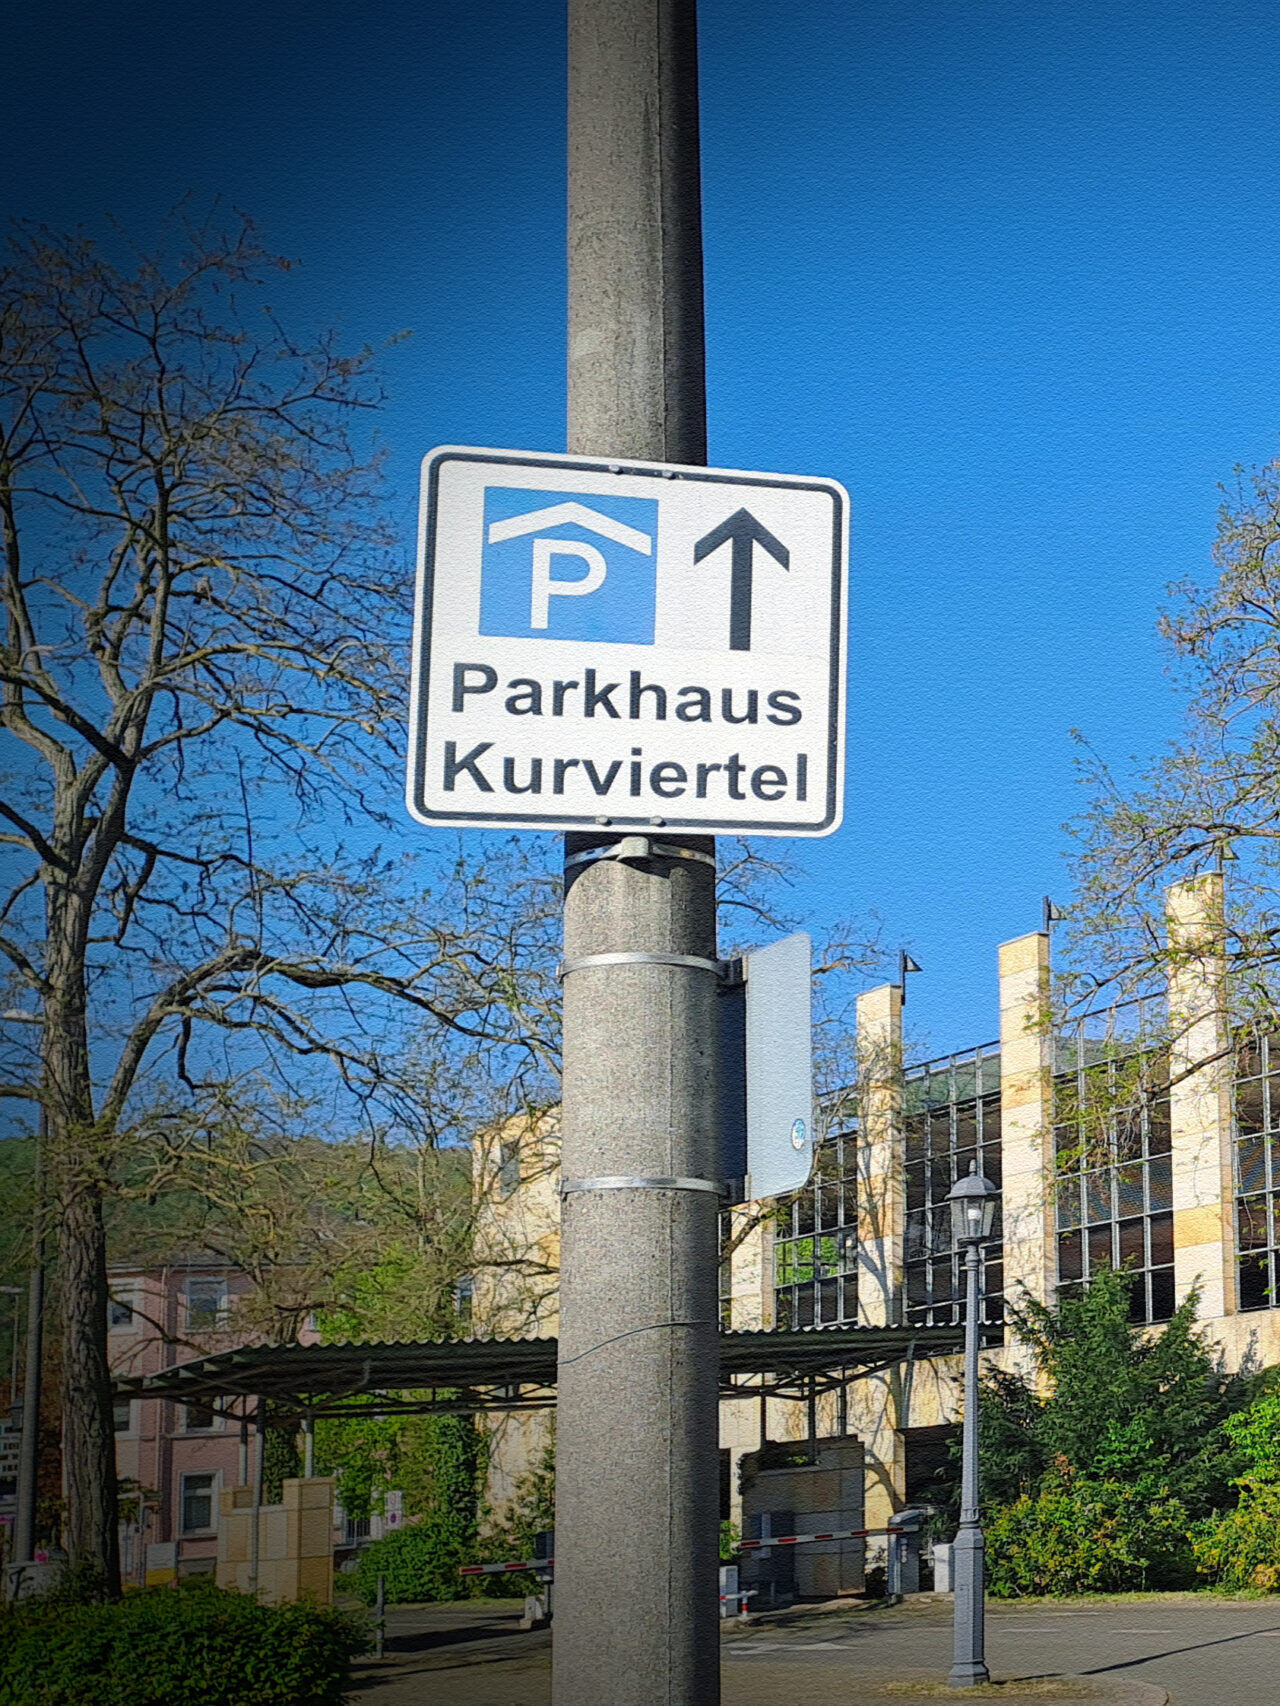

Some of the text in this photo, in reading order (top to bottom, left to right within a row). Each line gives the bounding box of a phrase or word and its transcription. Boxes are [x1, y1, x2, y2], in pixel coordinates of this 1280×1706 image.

[530, 538, 607, 630] P
[452, 662, 803, 726] Parkhaus
[443, 740, 808, 802] Kurviertel
